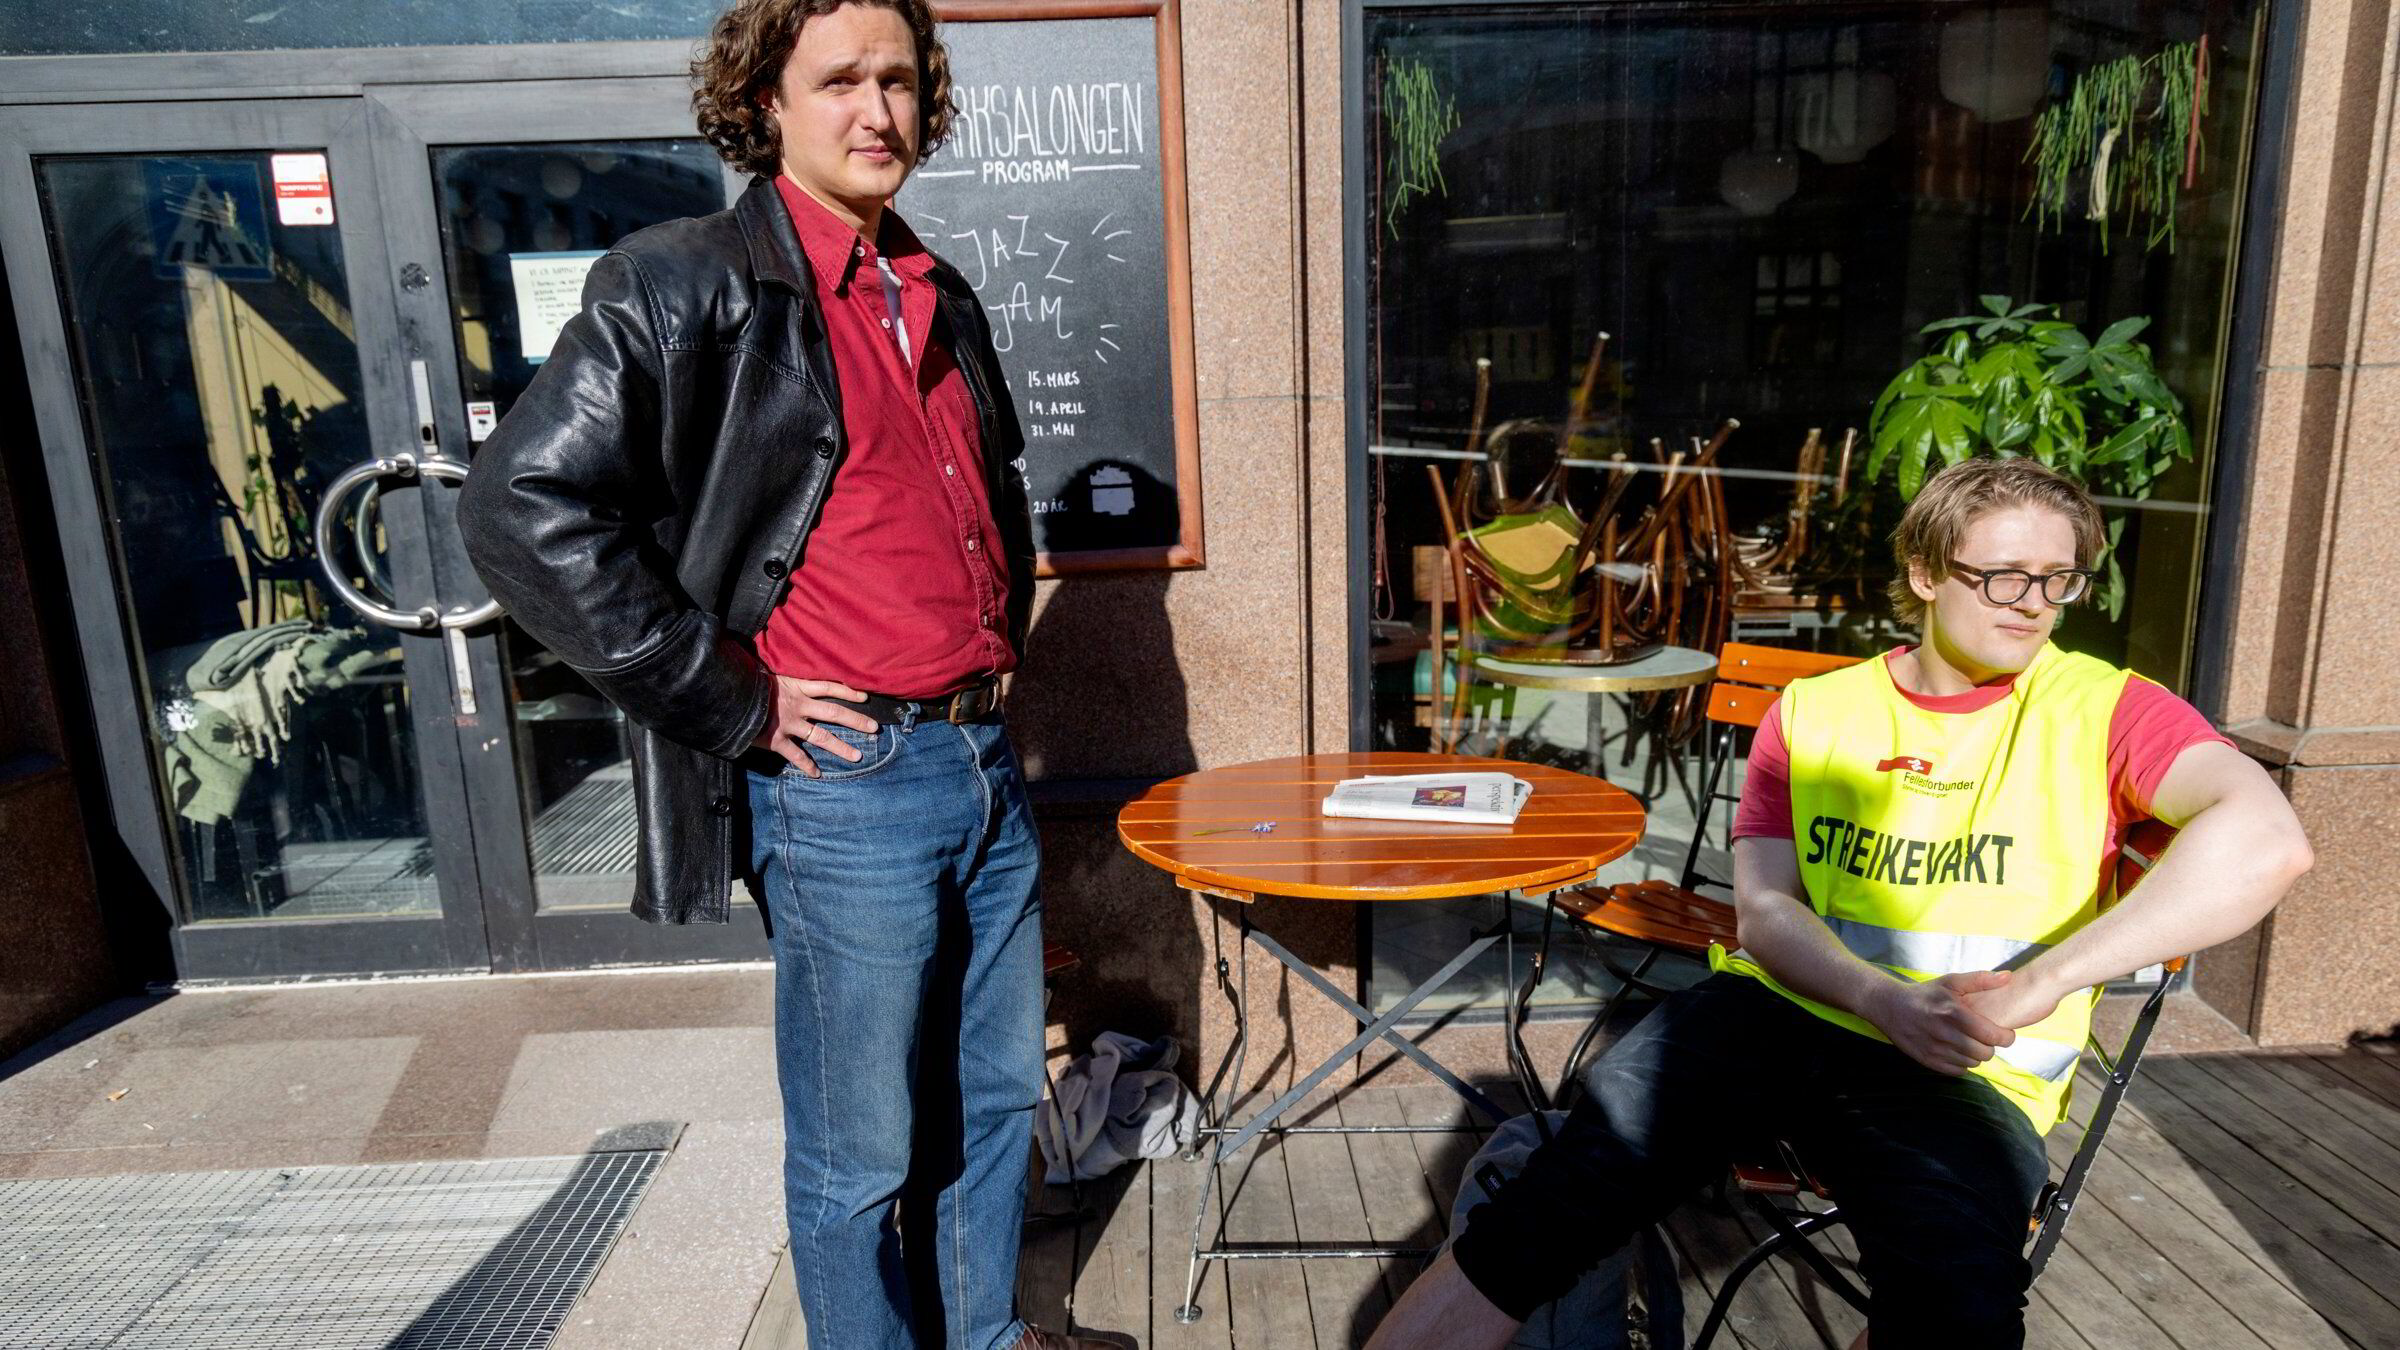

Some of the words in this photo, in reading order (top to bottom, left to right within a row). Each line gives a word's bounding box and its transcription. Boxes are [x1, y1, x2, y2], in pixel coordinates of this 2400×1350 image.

[933, 82, 1143, 158] RKSALONGEN
[982, 159, 1070, 185] PROGRAM
[951, 214, 1074, 291] JAZZ
[988, 282, 1074, 352] JAM
[1033, 501, 1048, 514] 20
[1903, 771, 1975, 792] Fellesforbundet
[1806, 815, 2014, 885] STREIKEVAKT
